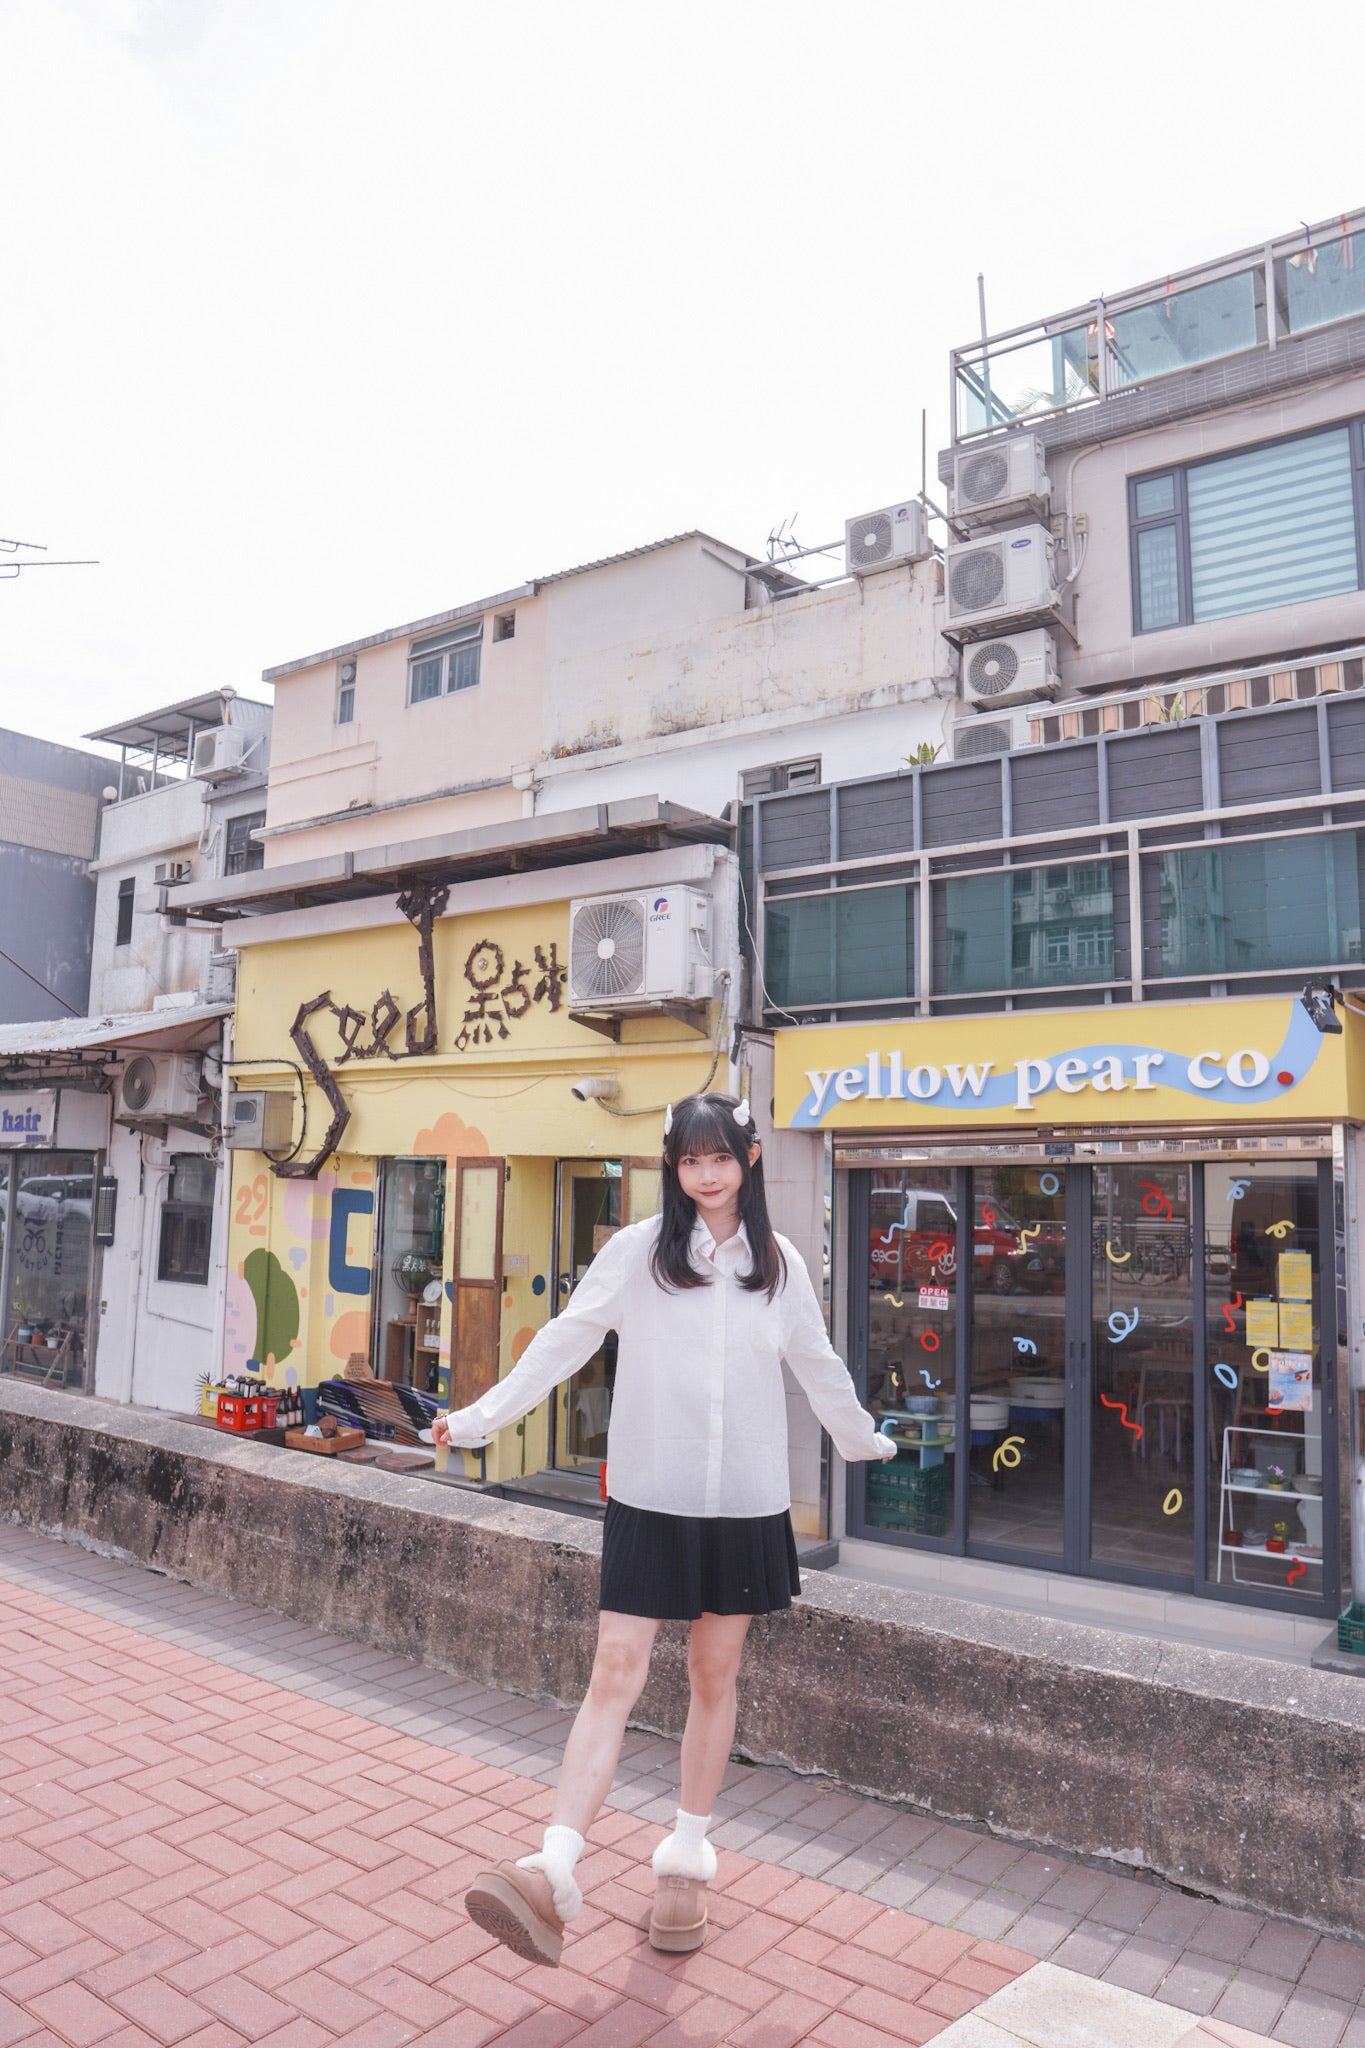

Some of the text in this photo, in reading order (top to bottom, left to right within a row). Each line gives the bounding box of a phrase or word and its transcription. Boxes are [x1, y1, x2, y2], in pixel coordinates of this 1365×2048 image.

[650, 912, 672, 922] GREE
[804, 1049, 1294, 1117] yellow pear co.
[2, 1107, 42, 1132] hair
[920, 1287, 948, 1297] OPEN
